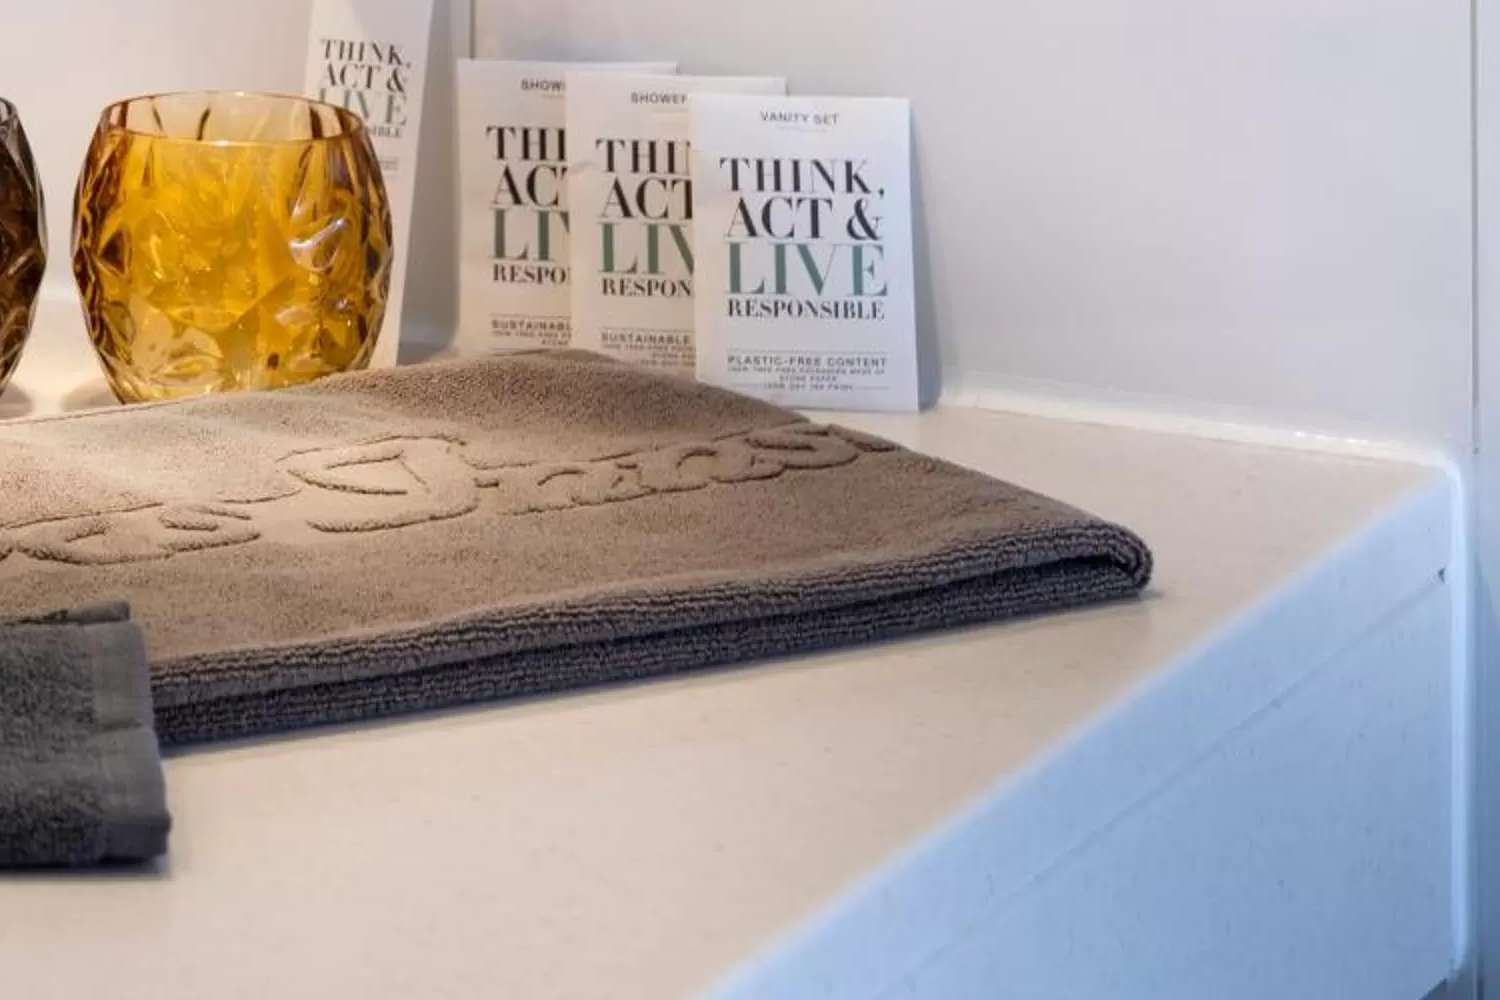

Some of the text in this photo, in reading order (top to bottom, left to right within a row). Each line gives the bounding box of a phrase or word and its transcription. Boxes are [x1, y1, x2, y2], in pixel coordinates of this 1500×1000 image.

[323, 62, 409, 93] ACT &
[520, 79, 566, 92] SHOW
[760, 110, 840, 125] VANITY SET
[486, 125, 566, 161] THI
[719, 157, 885, 198] THINK,
[724, 195, 884, 241] ACT &
[489, 207, 570, 261] LI
[598, 221, 695, 276] LIV
[492, 263, 570, 285] RESPO
[724, 240, 888, 297] LIVE
[601, 277, 694, 298] RESPON
[727, 298, 886, 320] RESPONSIBLE
[490, 319, 572, 331] SUSTAINABL
[827, 356, 888, 368] CONTENT
